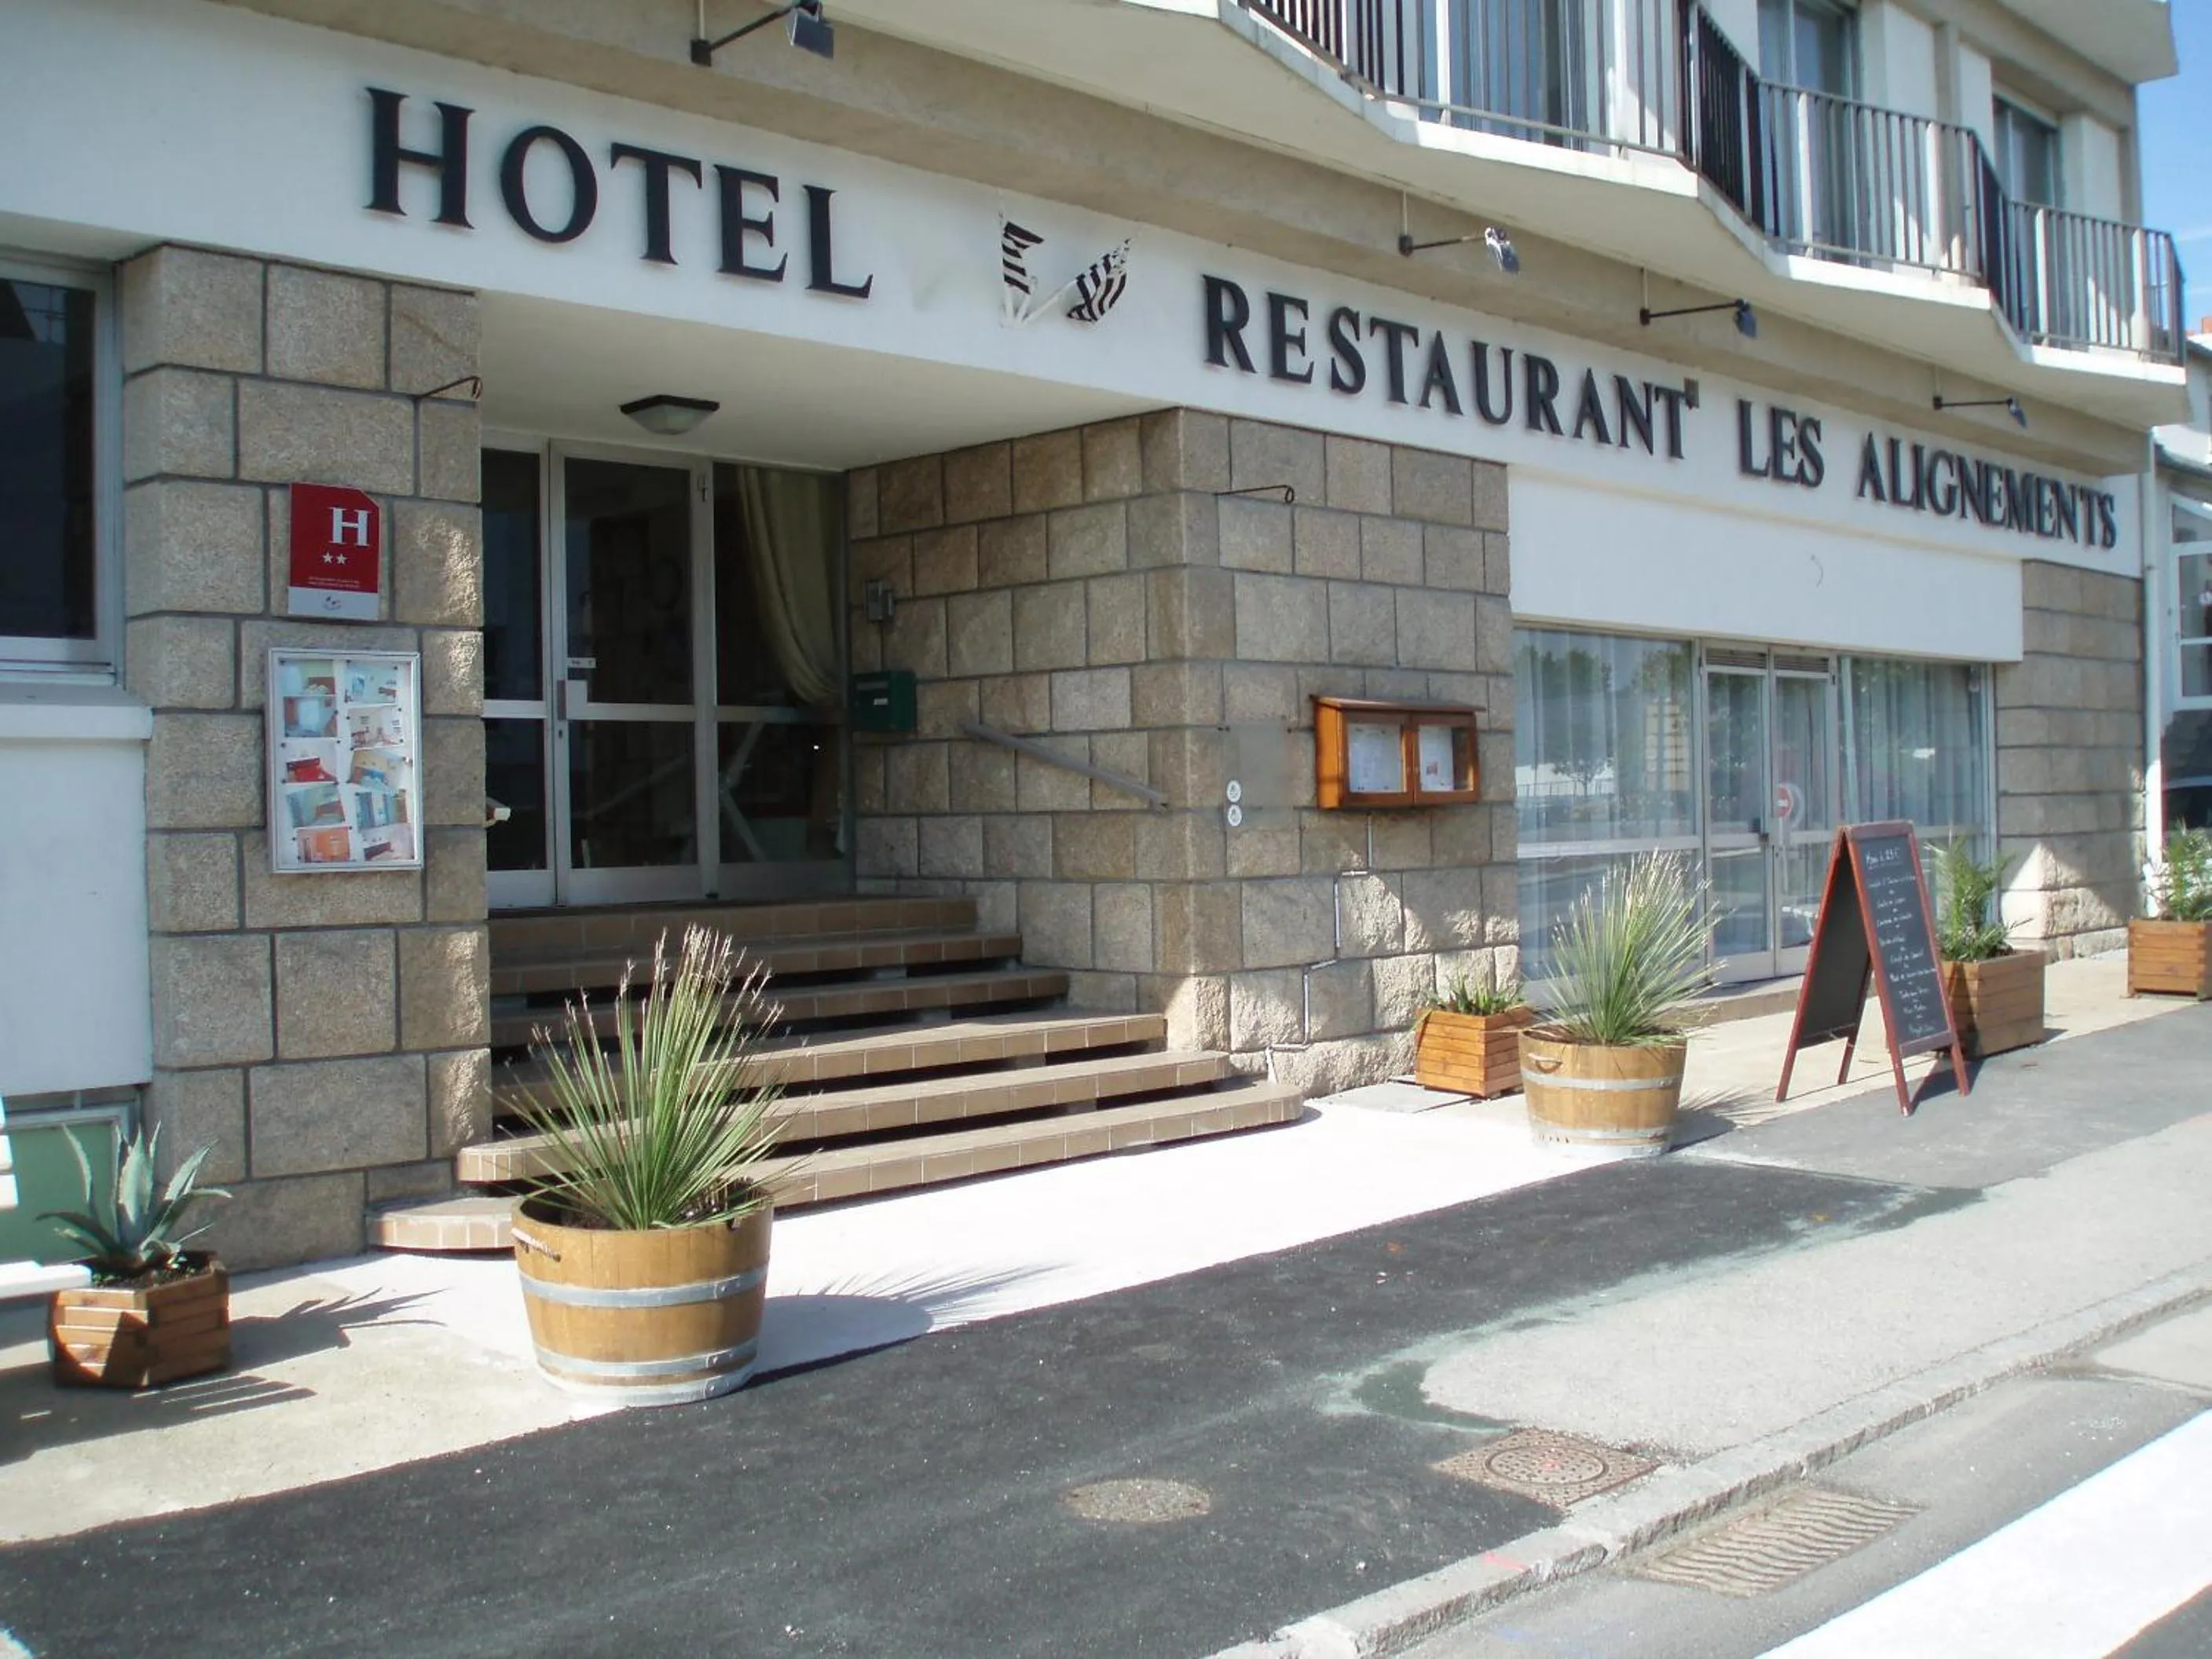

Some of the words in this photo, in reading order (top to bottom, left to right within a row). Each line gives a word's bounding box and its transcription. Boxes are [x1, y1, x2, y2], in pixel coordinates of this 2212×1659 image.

[363, 86, 874, 299] HOTEL
[1201, 273, 1695, 460] RESTAURANT
[1737, 398, 1826, 489] LES
[1857, 430, 2118, 550] ALIGNEMENTS
[327, 506, 373, 548] H
